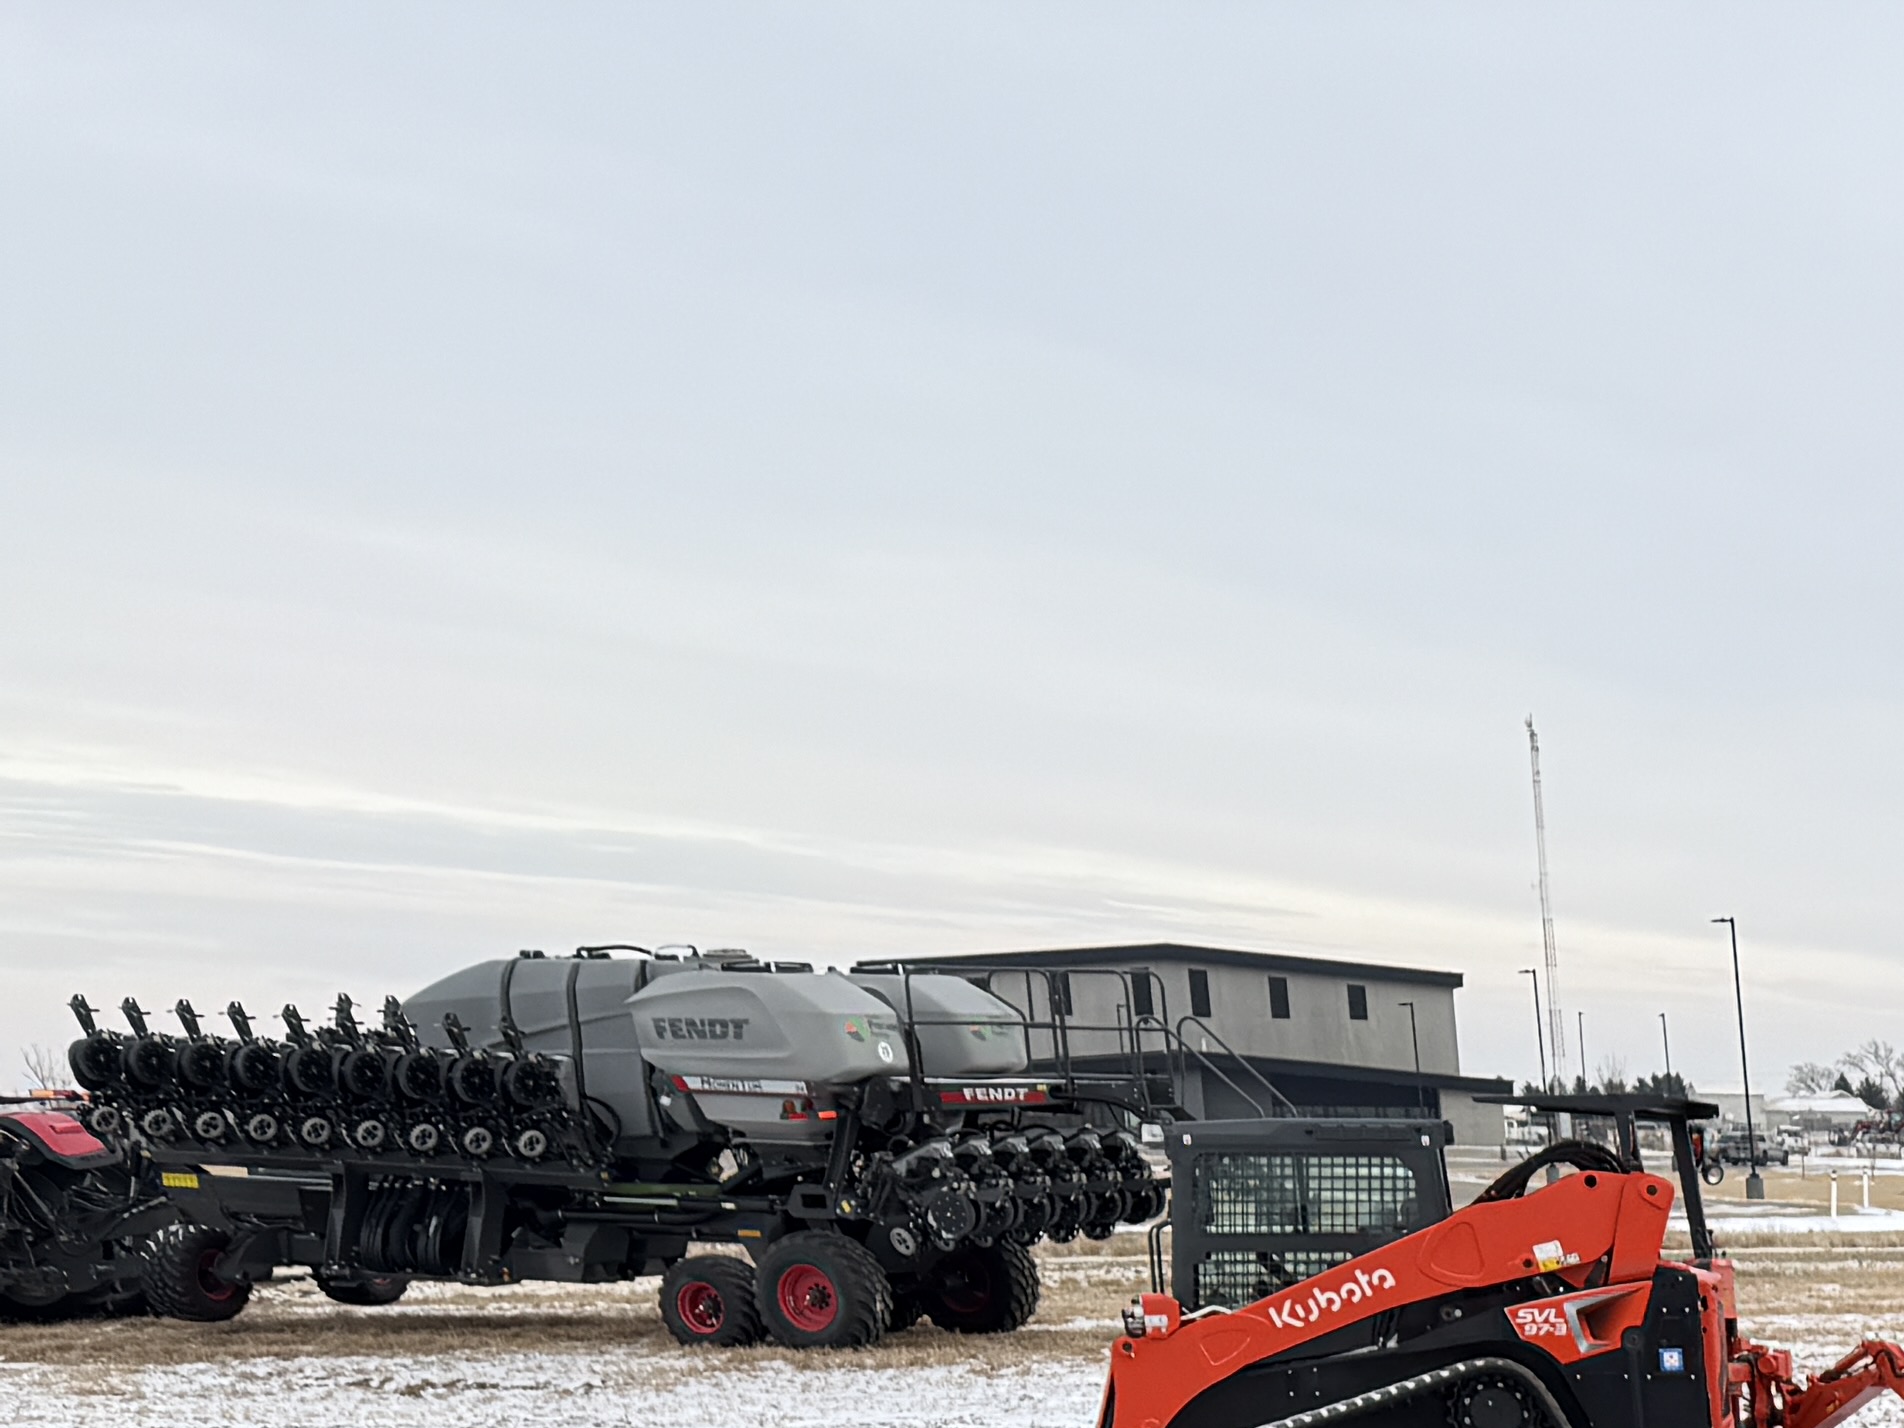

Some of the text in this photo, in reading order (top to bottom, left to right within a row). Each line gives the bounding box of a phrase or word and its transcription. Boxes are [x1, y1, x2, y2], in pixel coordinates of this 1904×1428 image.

[652, 1017, 750, 1041] FENDT
[962, 1086, 1029, 1101] FENDT
[1268, 1268, 1396, 1329] Kubota
[1515, 1307, 1565, 1324] SVL
